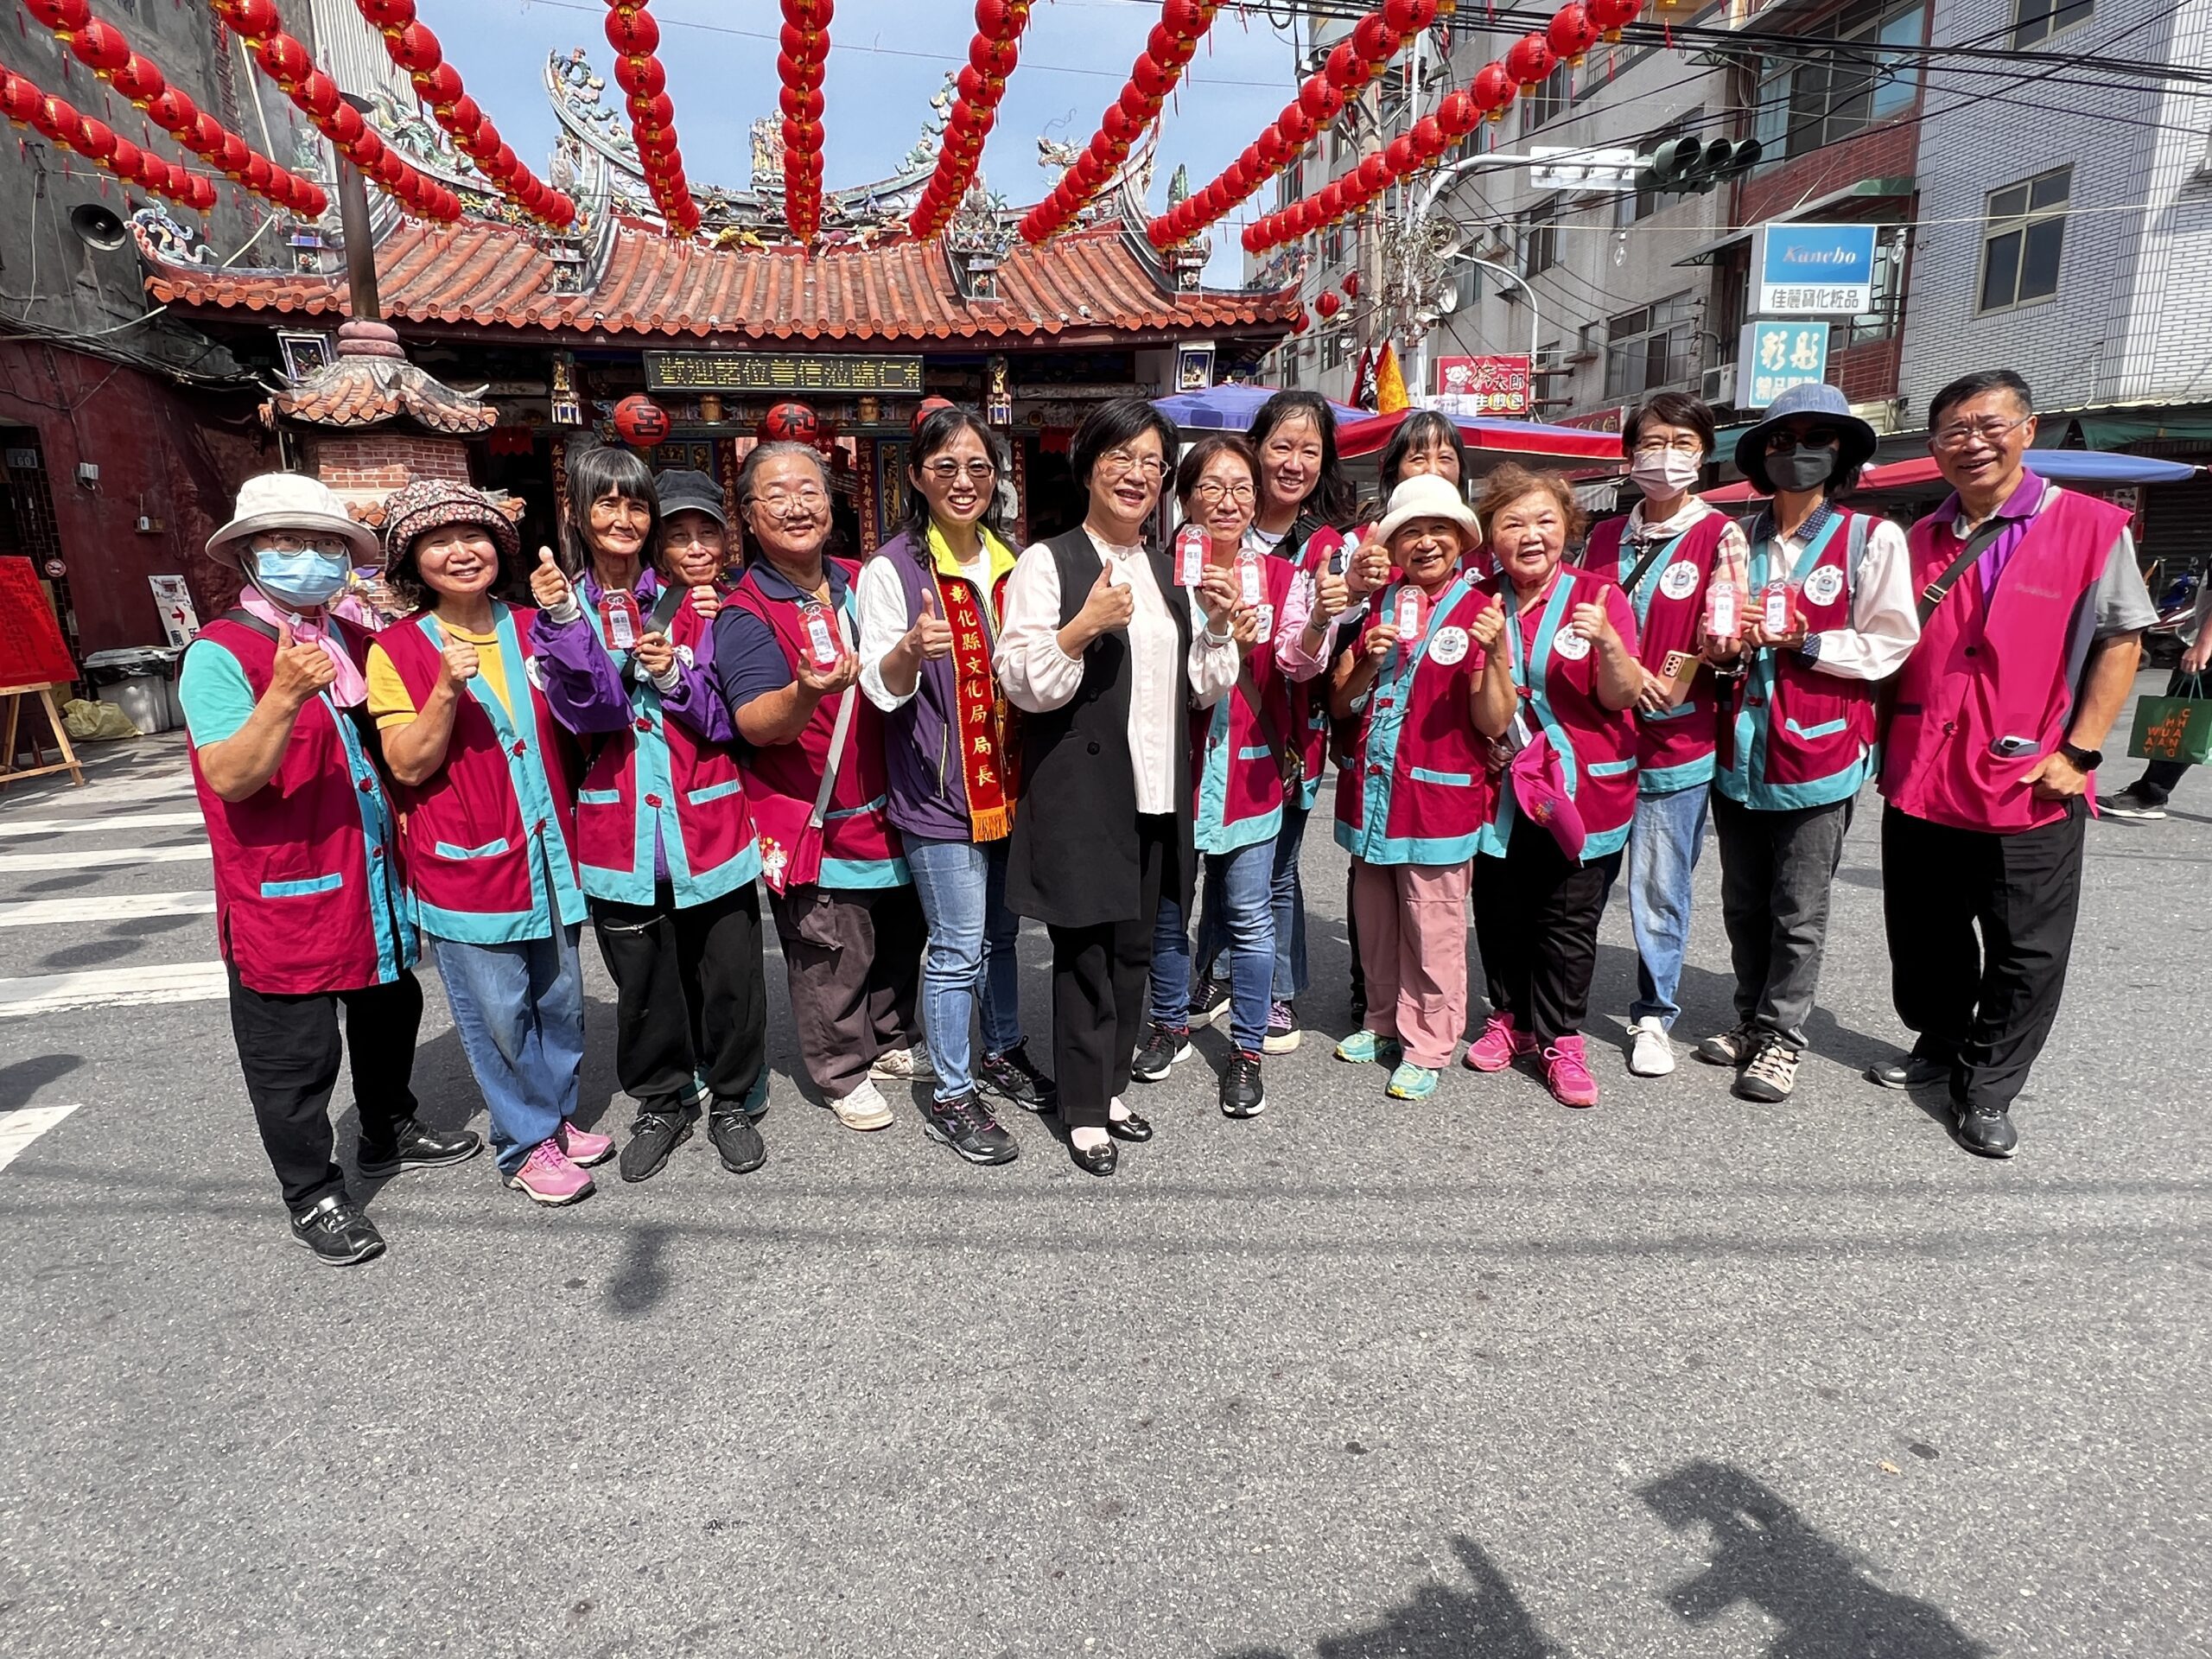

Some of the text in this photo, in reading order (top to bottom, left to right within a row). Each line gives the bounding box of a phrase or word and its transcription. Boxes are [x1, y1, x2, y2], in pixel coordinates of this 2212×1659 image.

[1783, 245, 1856, 264] Kanebo
[626, 397, 664, 436] 宮
[778, 404, 817, 435] 和
